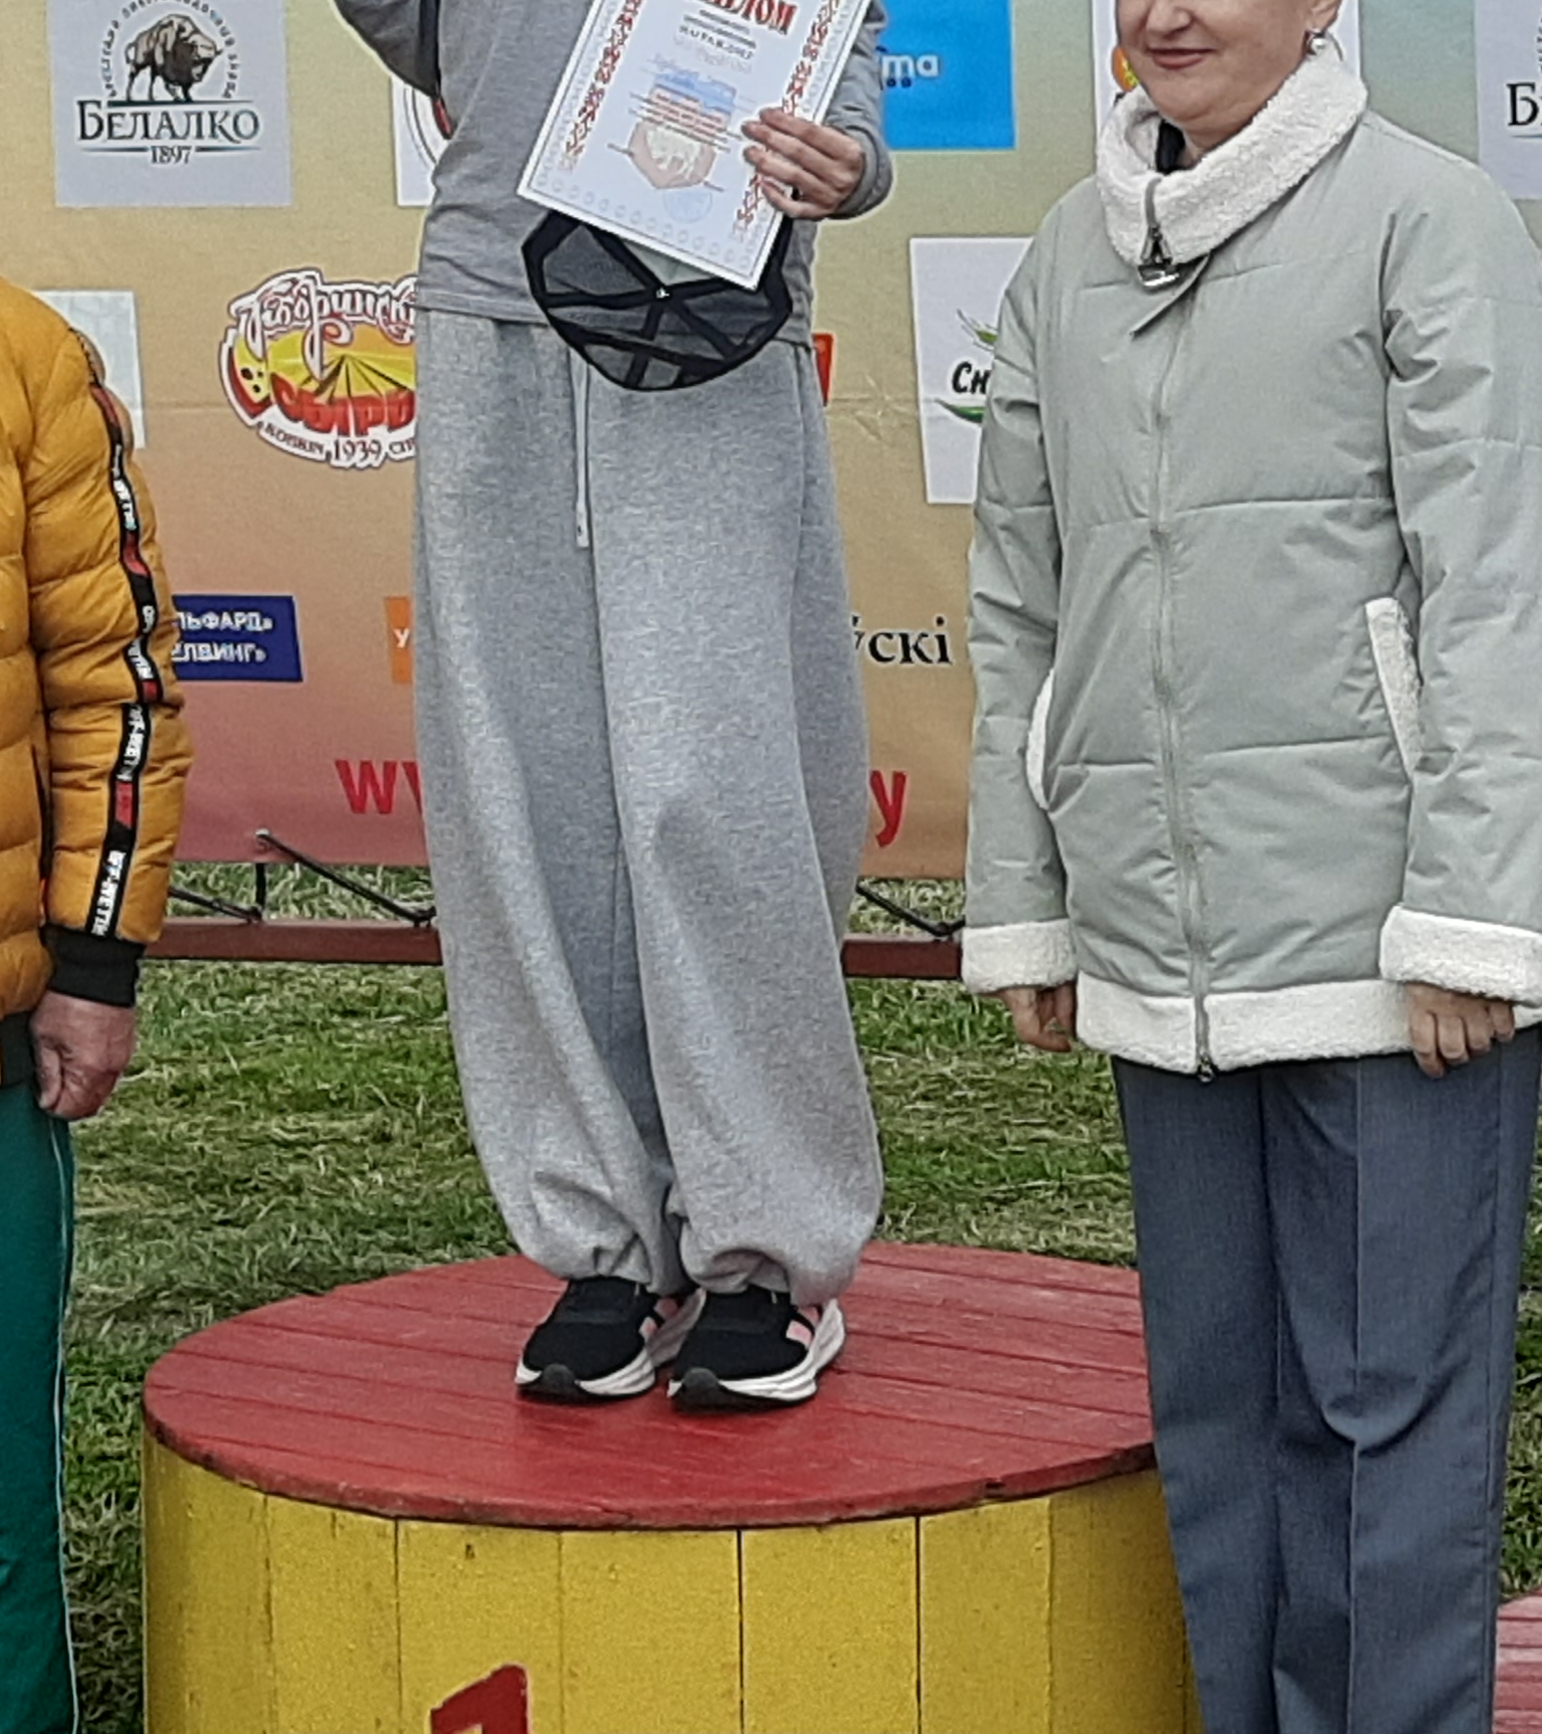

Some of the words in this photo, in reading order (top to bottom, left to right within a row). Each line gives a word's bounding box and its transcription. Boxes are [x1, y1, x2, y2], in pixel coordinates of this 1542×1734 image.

[77, 100, 260, 144] БЕЛАЛКО
[151, 145, 192, 164] 1897
[333, 439, 382, 461] 1939
